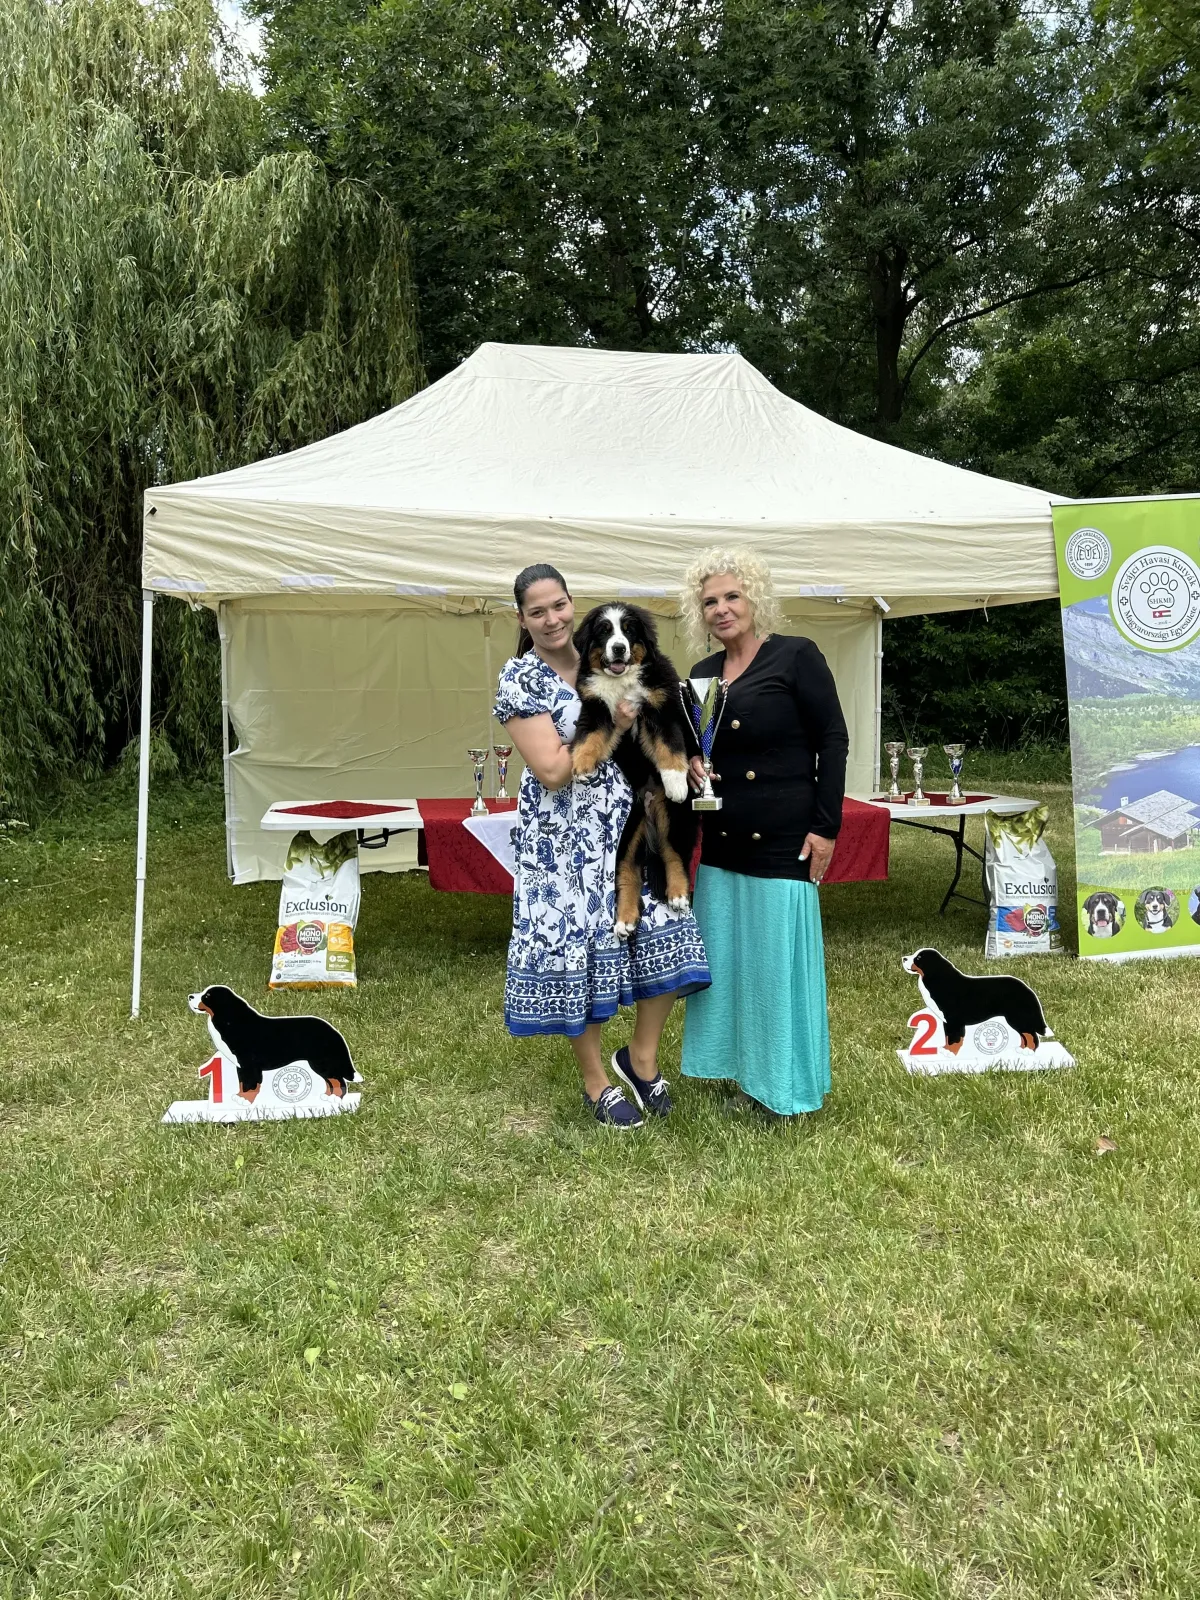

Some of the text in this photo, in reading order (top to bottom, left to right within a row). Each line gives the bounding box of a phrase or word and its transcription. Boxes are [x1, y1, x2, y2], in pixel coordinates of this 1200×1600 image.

[1121, 556, 1197, 591] Svájci Havasi Kutyák
[1124, 606, 1197, 640] Magyarországi Egyesülete
[286, 896, 347, 913] Exclusion
[1004, 880, 1056, 895] Exclusion
[910, 1013, 938, 1056] 2
[200, 1058, 222, 1103] 1
